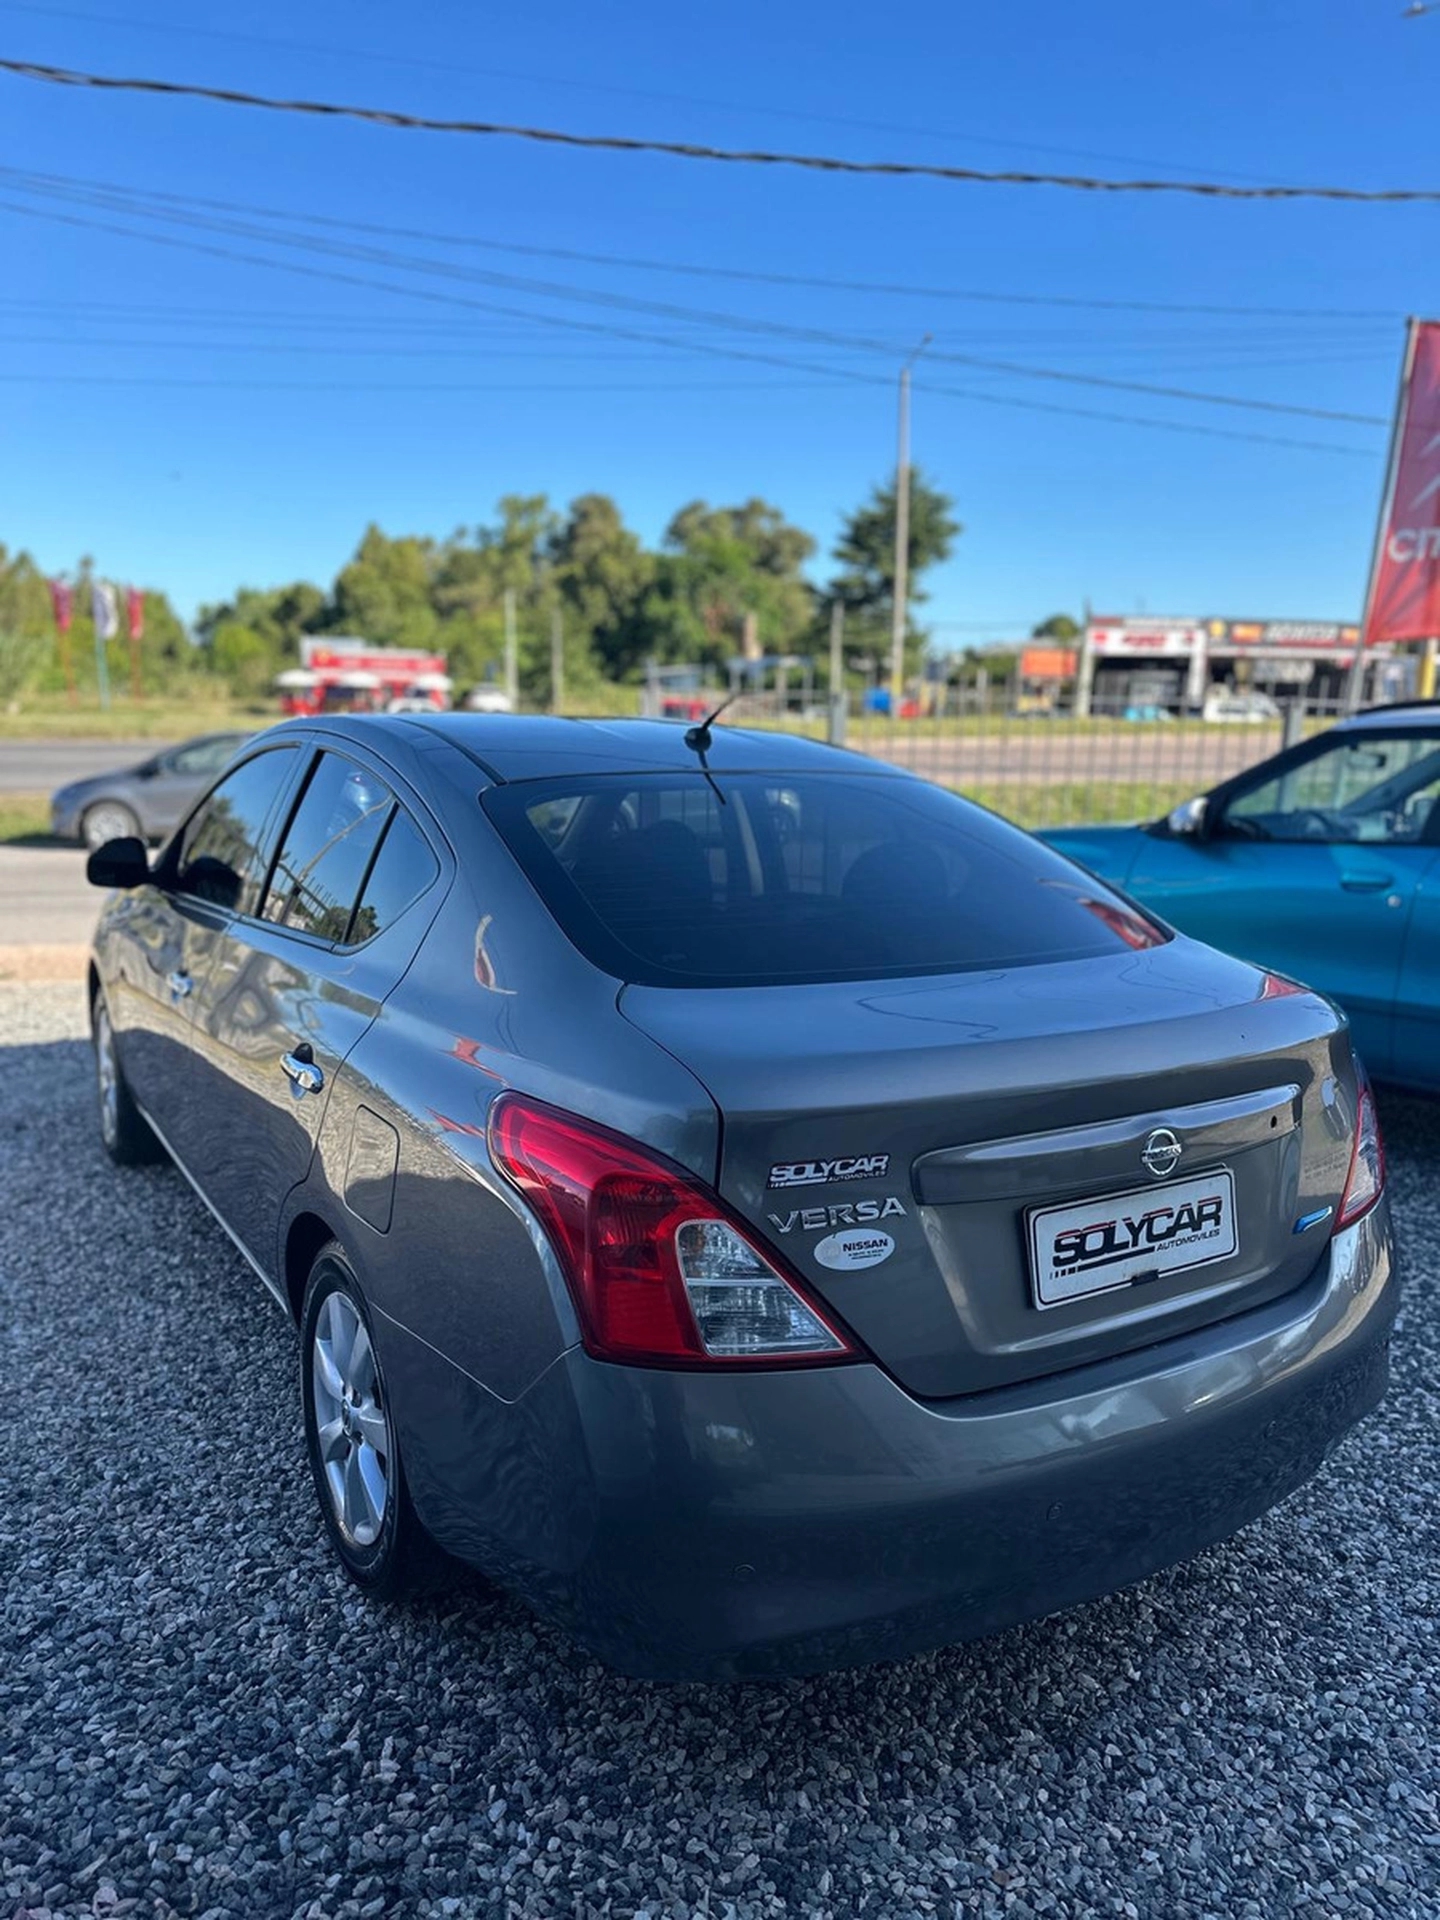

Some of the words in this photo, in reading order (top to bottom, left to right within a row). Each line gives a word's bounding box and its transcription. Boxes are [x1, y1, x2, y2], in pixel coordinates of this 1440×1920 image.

[769, 1155, 889, 1182] SOLYCAR
[828, 1170, 886, 1182] AUTOMOVILES
[767, 1197, 907, 1234] VERSA
[1052, 1196, 1223, 1267] SOLYCAR
[1156, 1228, 1221, 1252] AUTOMOVILES
[842, 1238, 889, 1252] NISSAN
